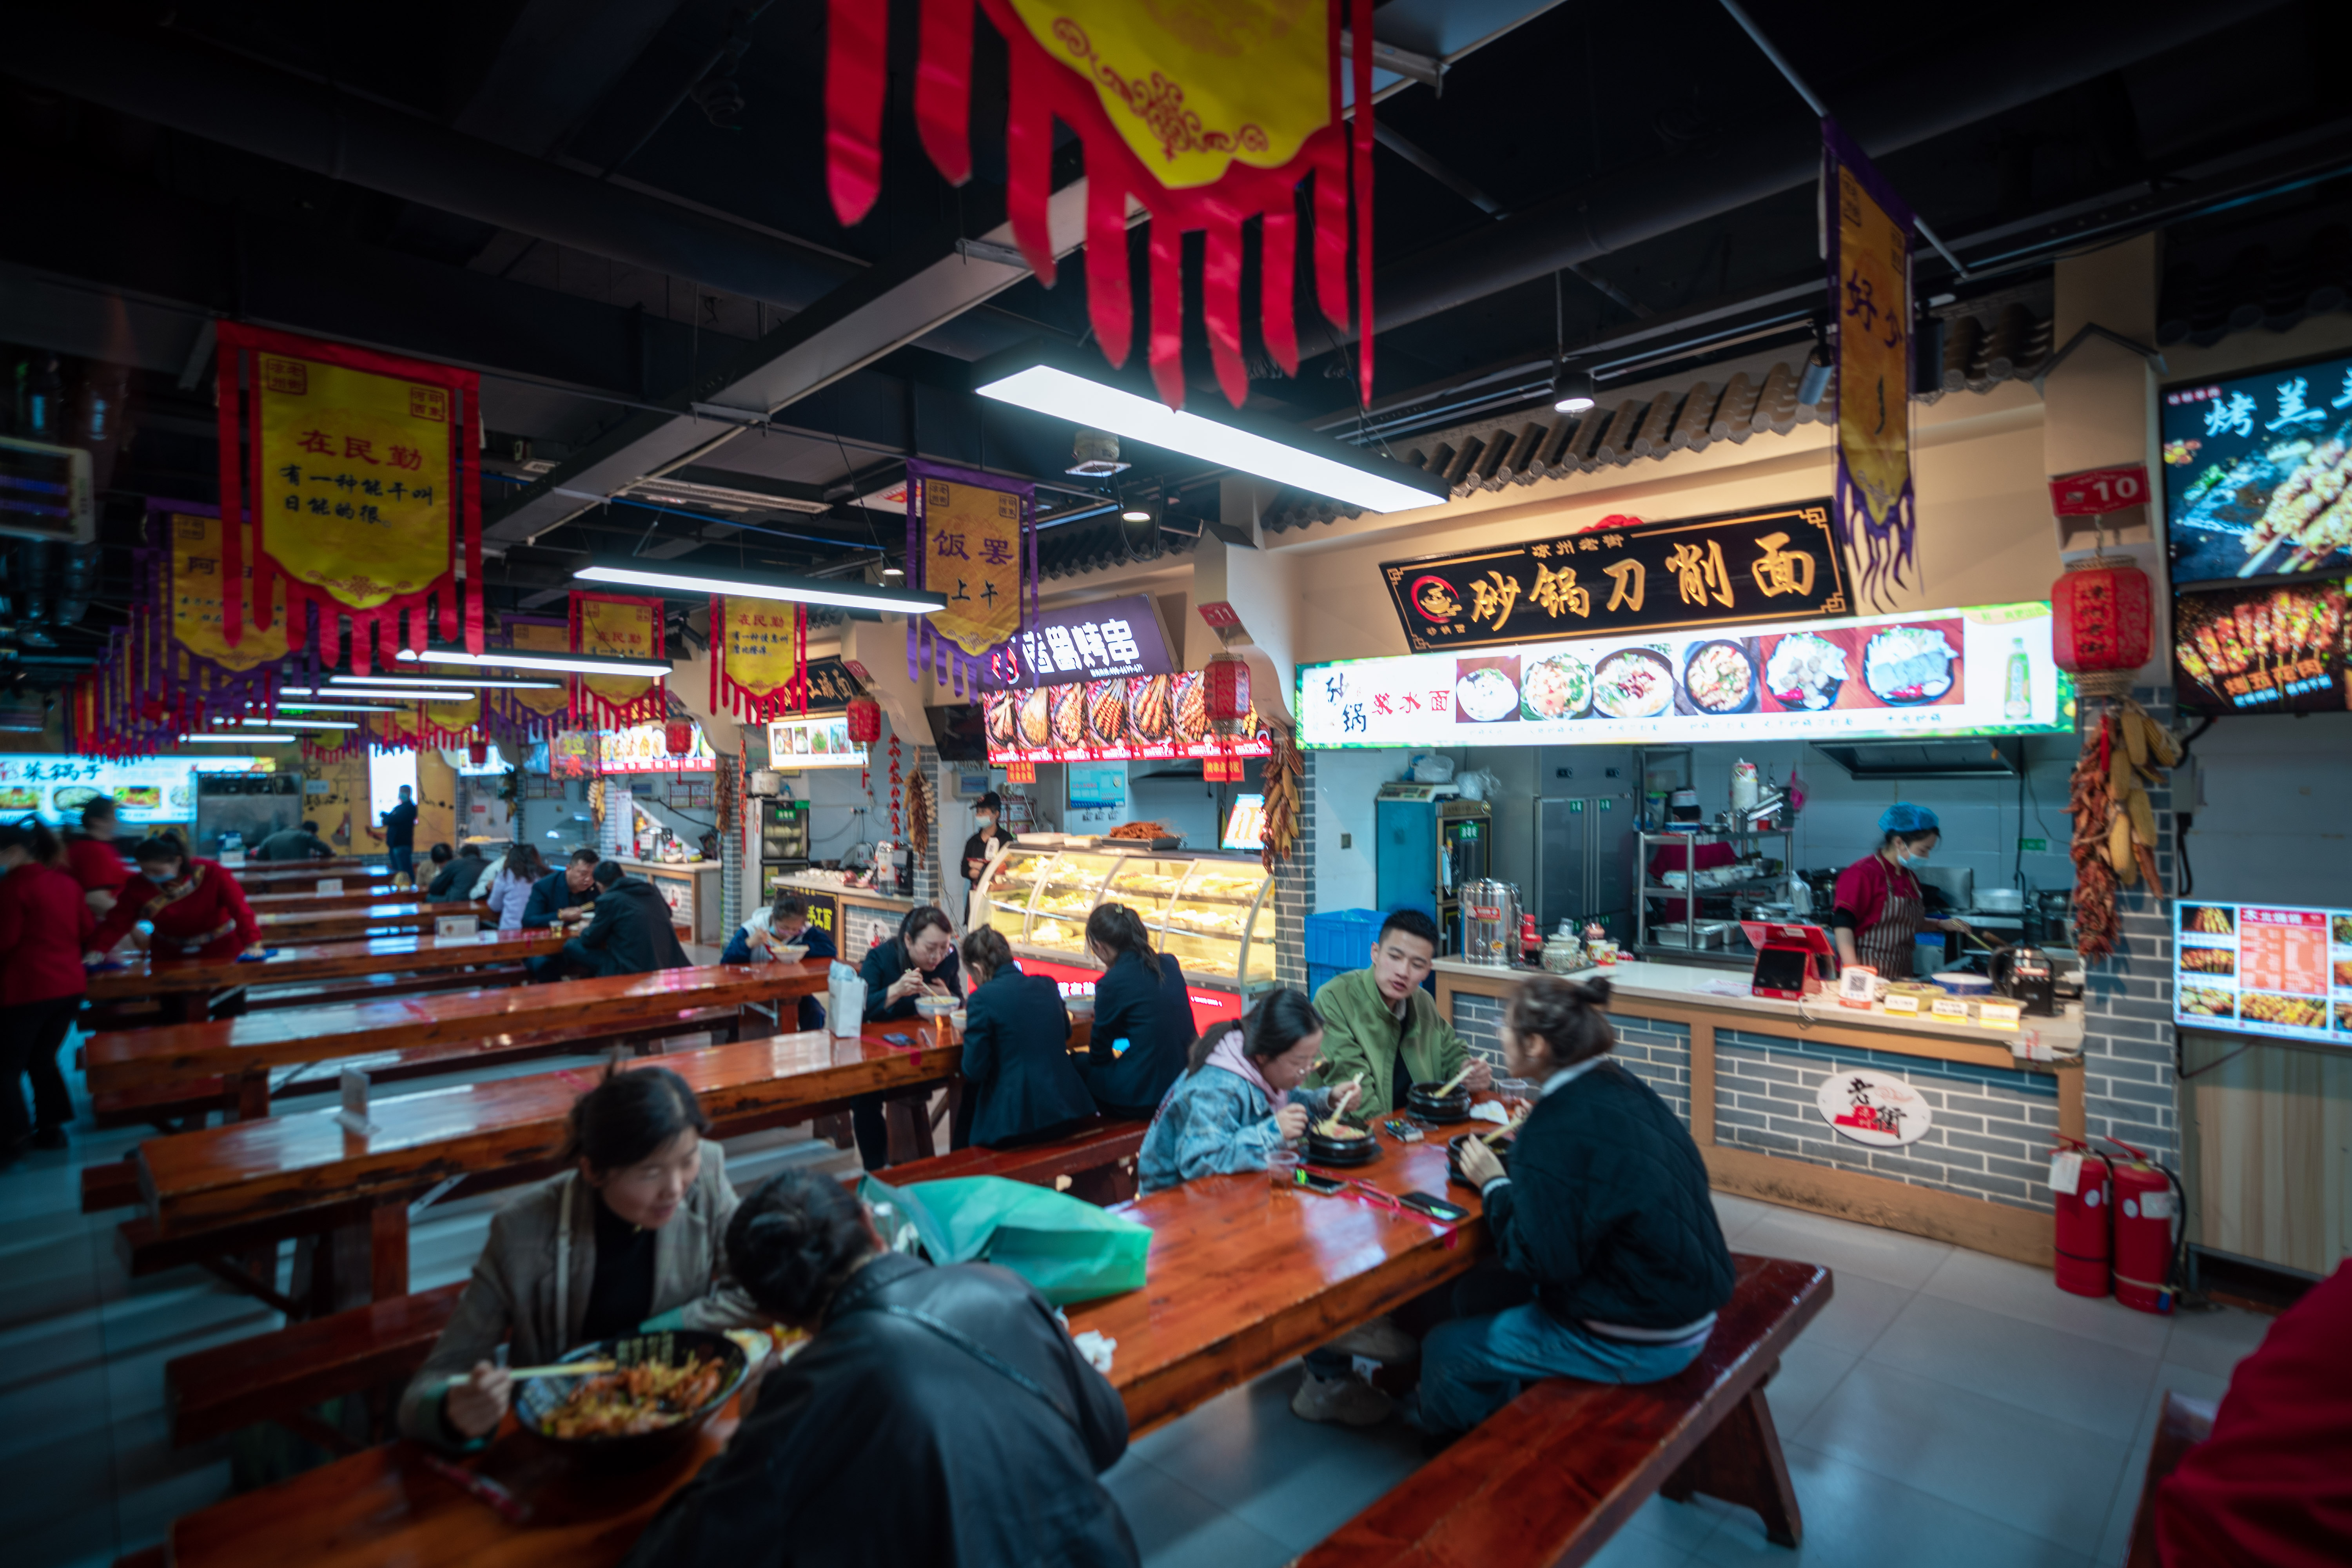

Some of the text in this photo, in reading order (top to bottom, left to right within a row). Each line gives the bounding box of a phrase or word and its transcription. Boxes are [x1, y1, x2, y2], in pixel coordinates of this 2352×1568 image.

[297, 429, 422, 471] 在民勤
[279, 463, 432, 506] 有一种能干叫
[2092, 476, 2139, 502] 10
[933, 530, 1013, 565] 饭罢
[951, 579, 998, 609] 上午
[1468, 532, 1815, 632] 砂锅刀削面
[738, 613, 784, 629] 在民勤
[1214, 608, 1233, 621] 11
[1325, 672, 1367, 733] 砂锅
[1372, 690, 1450, 715] 浆水面
